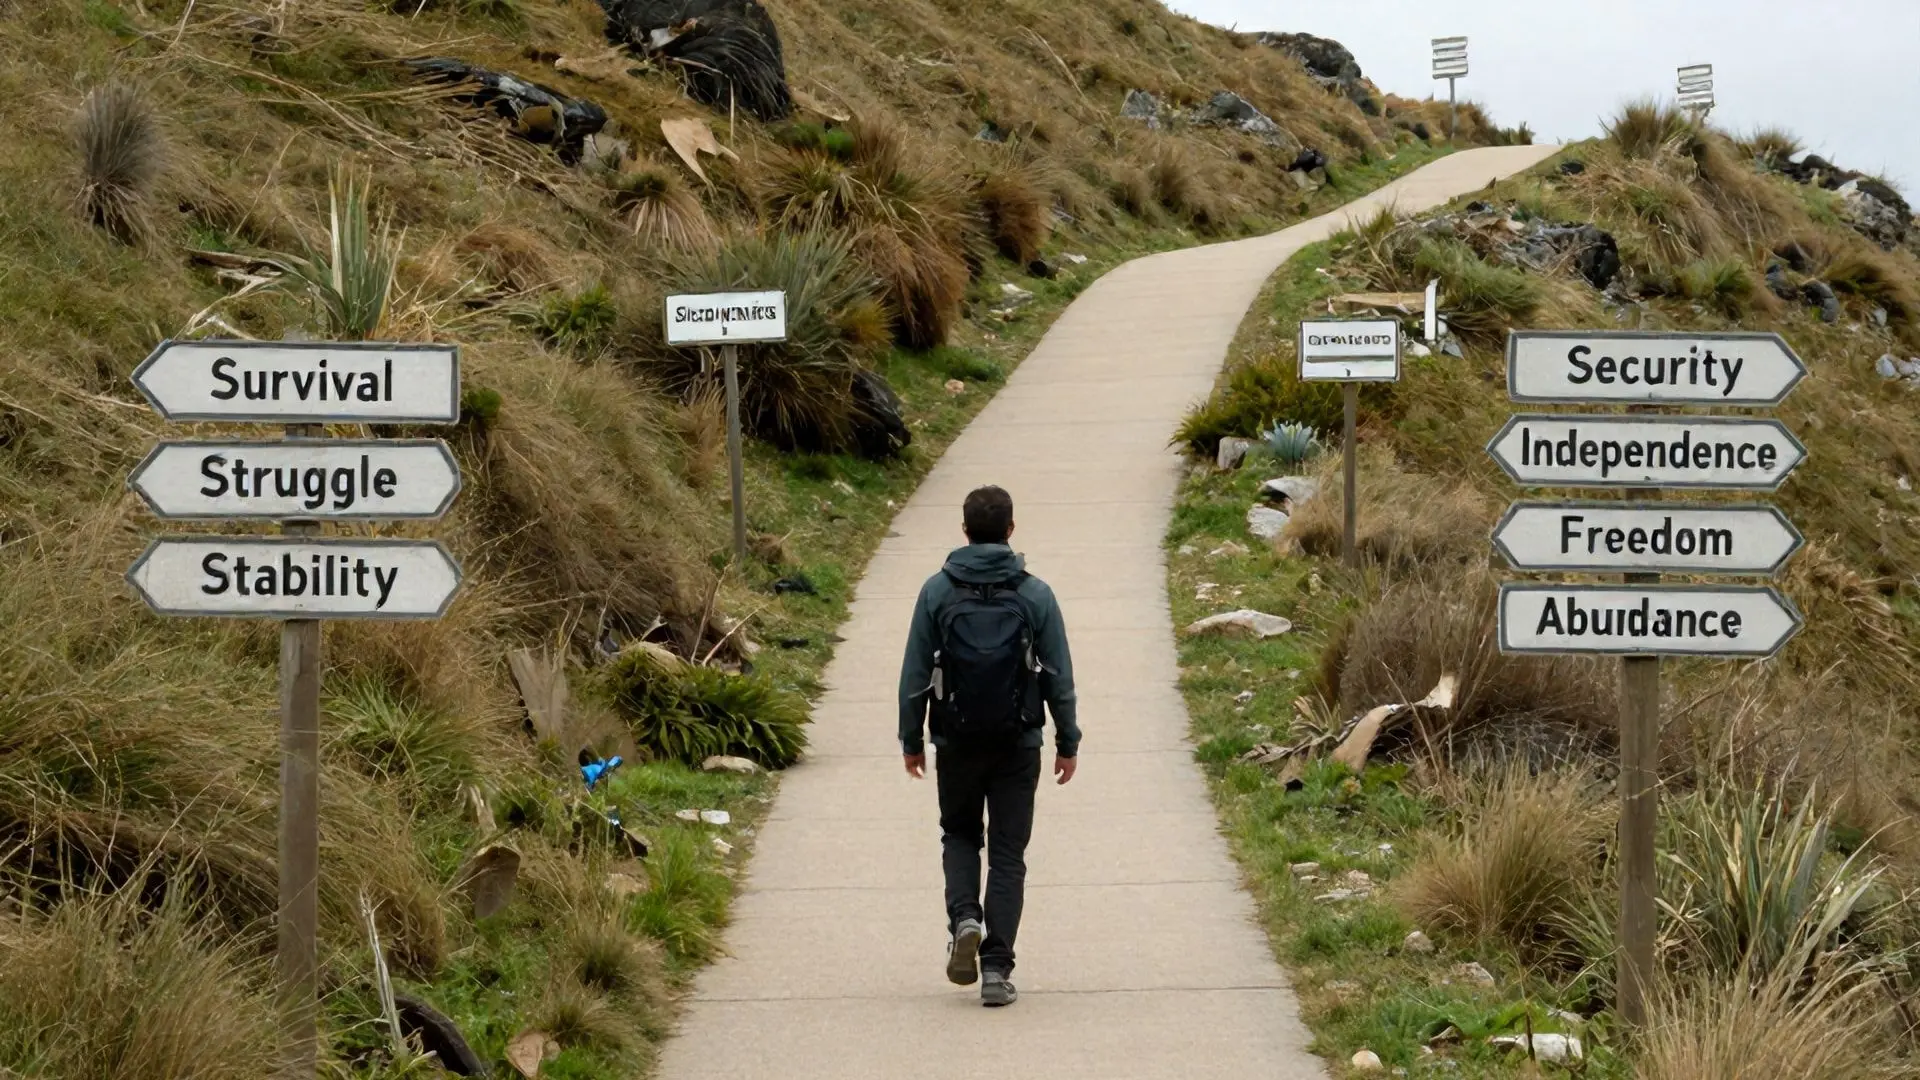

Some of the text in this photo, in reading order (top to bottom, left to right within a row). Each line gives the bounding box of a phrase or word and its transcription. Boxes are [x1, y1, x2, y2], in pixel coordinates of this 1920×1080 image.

[210, 356, 393, 402] Survival
[1567, 345, 1744, 397] Security
[1521, 427, 1777, 478] Independence
[200, 454, 397, 511] Struggle
[1560, 515, 1733, 556] Freedom
[200, 551, 399, 611] Stability
